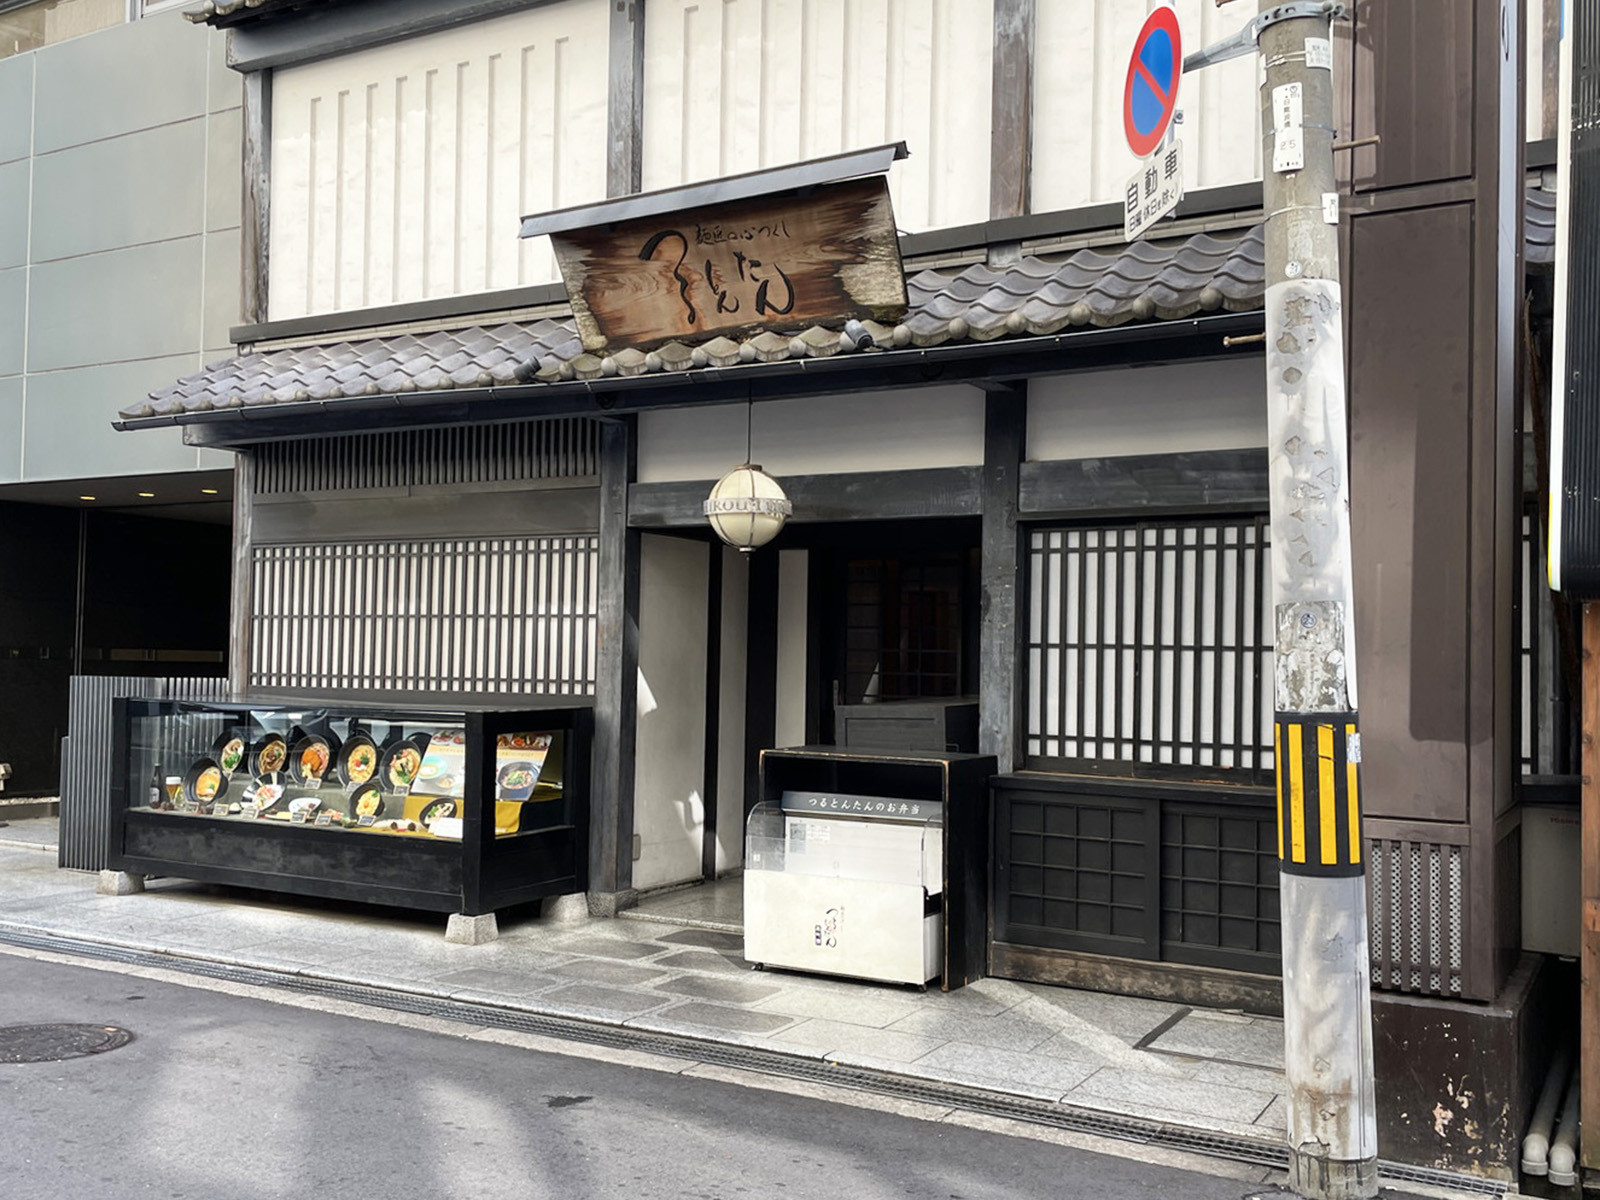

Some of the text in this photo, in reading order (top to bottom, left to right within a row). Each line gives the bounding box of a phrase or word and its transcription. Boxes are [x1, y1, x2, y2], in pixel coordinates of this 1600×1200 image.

[1127, 148, 1178, 214] 自動車
[638, 229, 795, 325] つるとんたん
[808, 797, 920, 815] つるとんたんのお弁当
